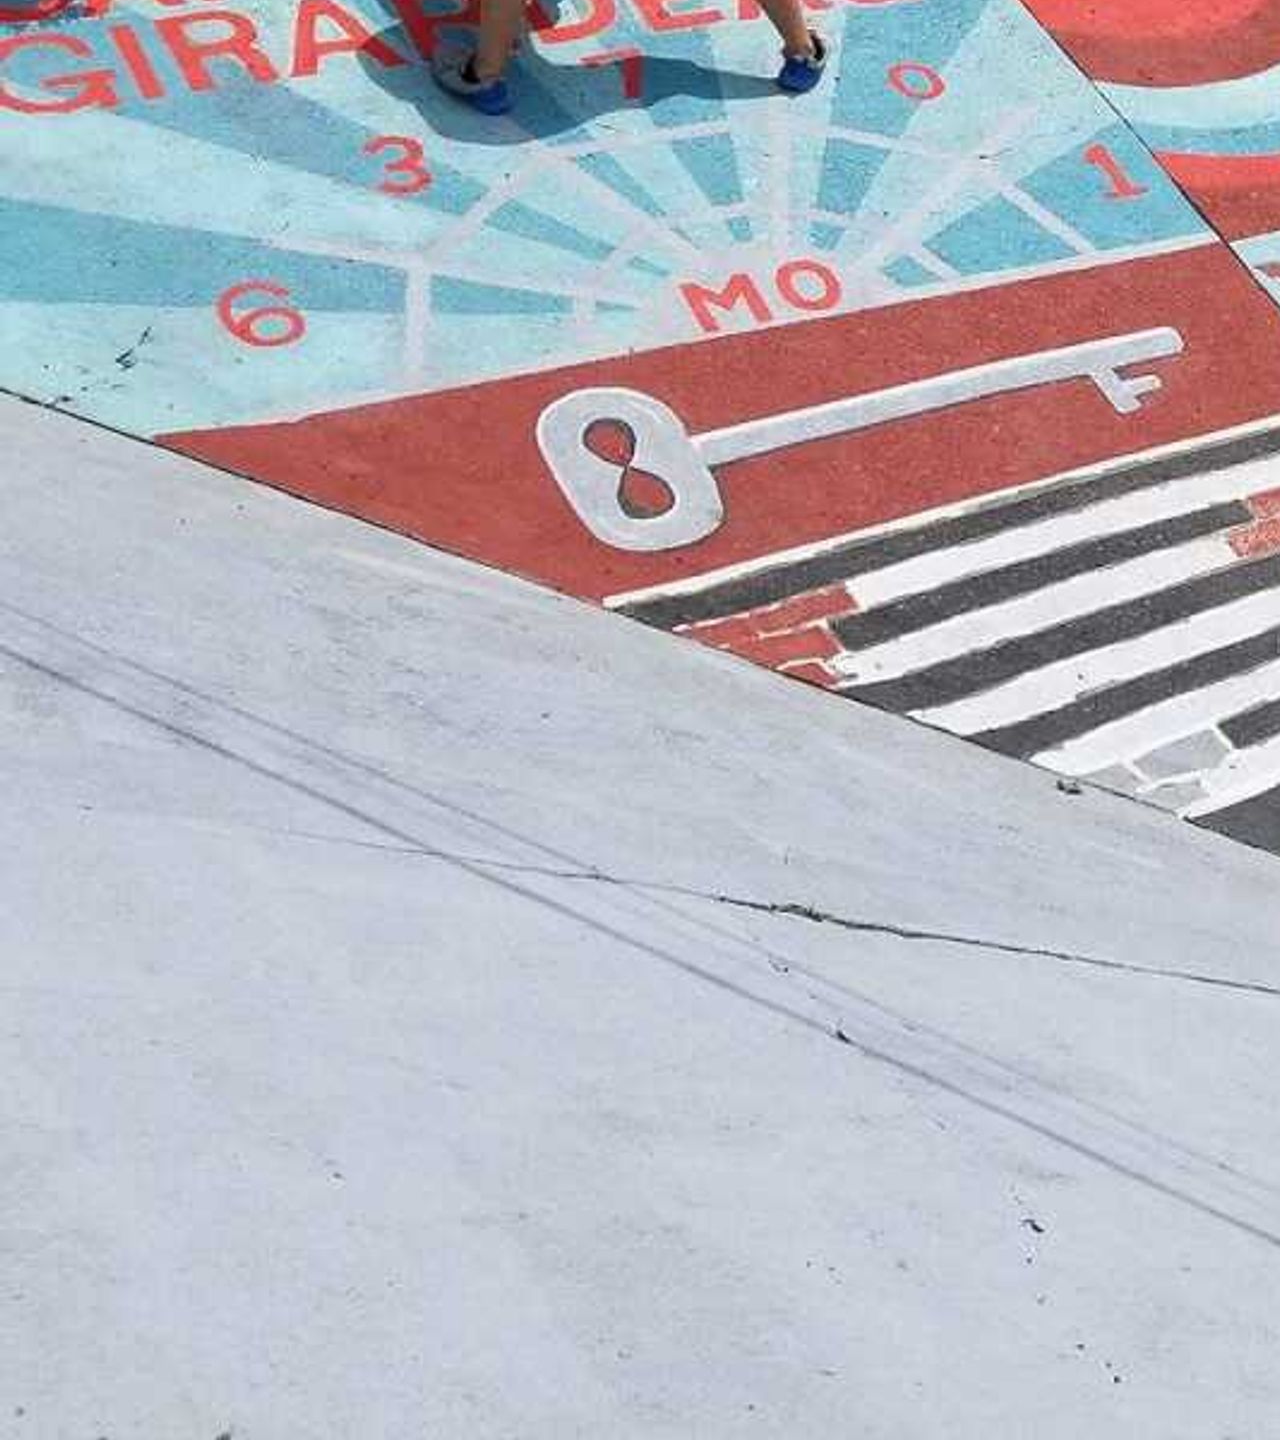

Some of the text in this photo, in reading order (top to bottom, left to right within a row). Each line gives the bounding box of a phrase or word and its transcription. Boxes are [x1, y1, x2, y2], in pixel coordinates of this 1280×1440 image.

[216, 279, 307, 348] 6
[362, 134, 433, 198] 3
[1083, 143, 1149, 199] 1
[679, 259, 842, 331] MO
